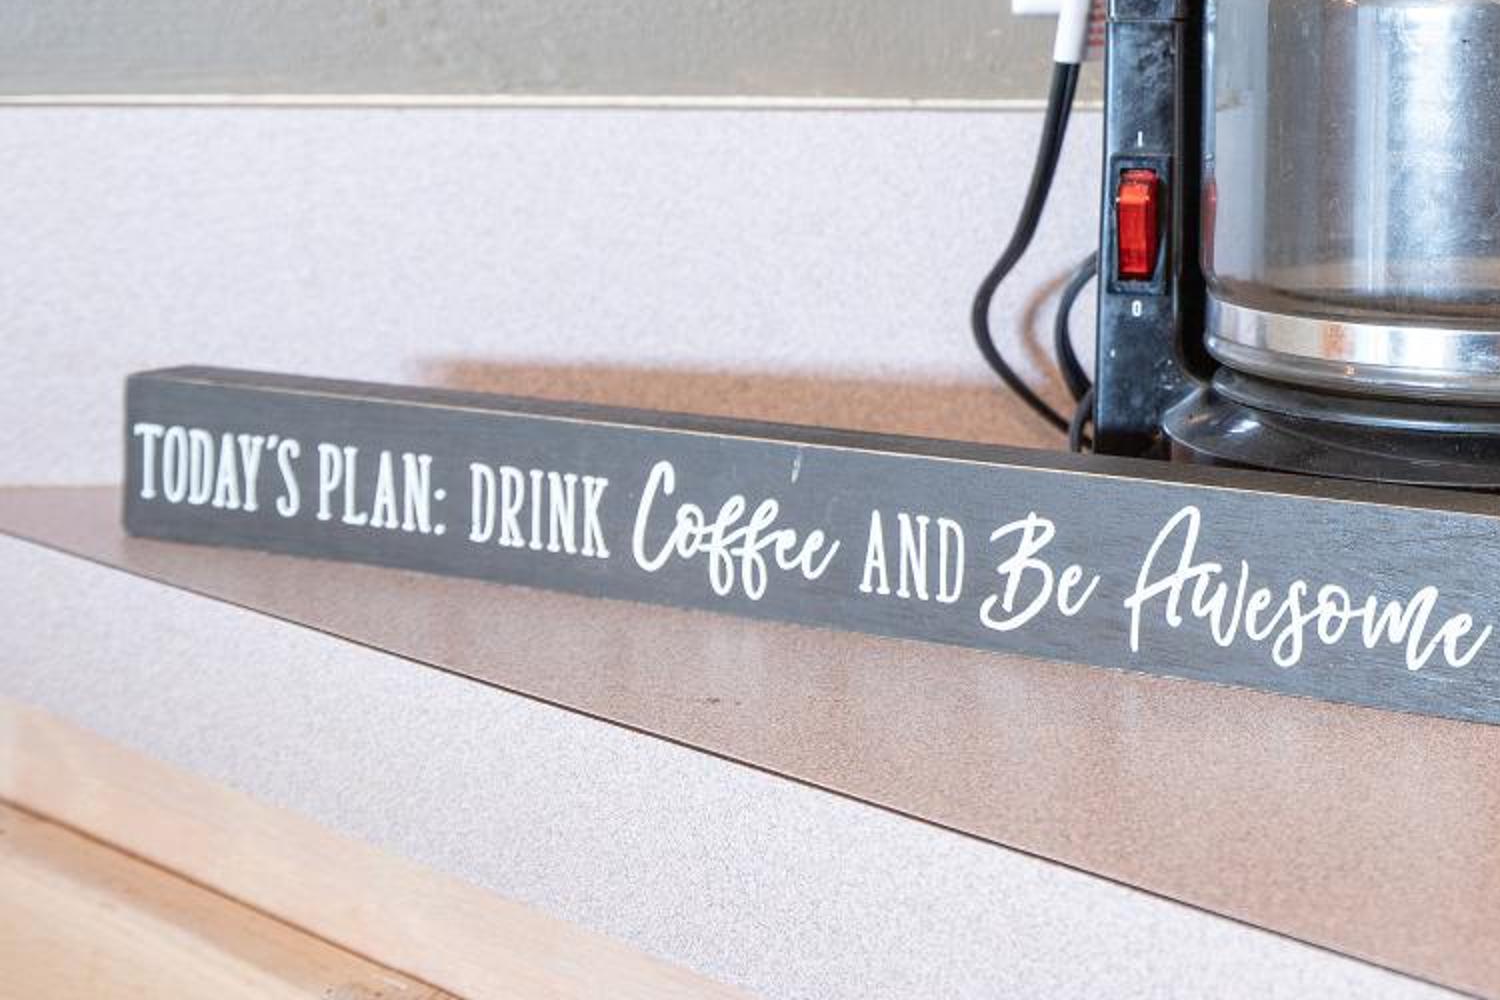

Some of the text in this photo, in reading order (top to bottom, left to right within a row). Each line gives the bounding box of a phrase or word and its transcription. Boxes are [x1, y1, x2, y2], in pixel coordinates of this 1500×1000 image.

[134, 422, 1493, 671] TODAY'S PLAN: DRINK Coffee AND Be Awesome
